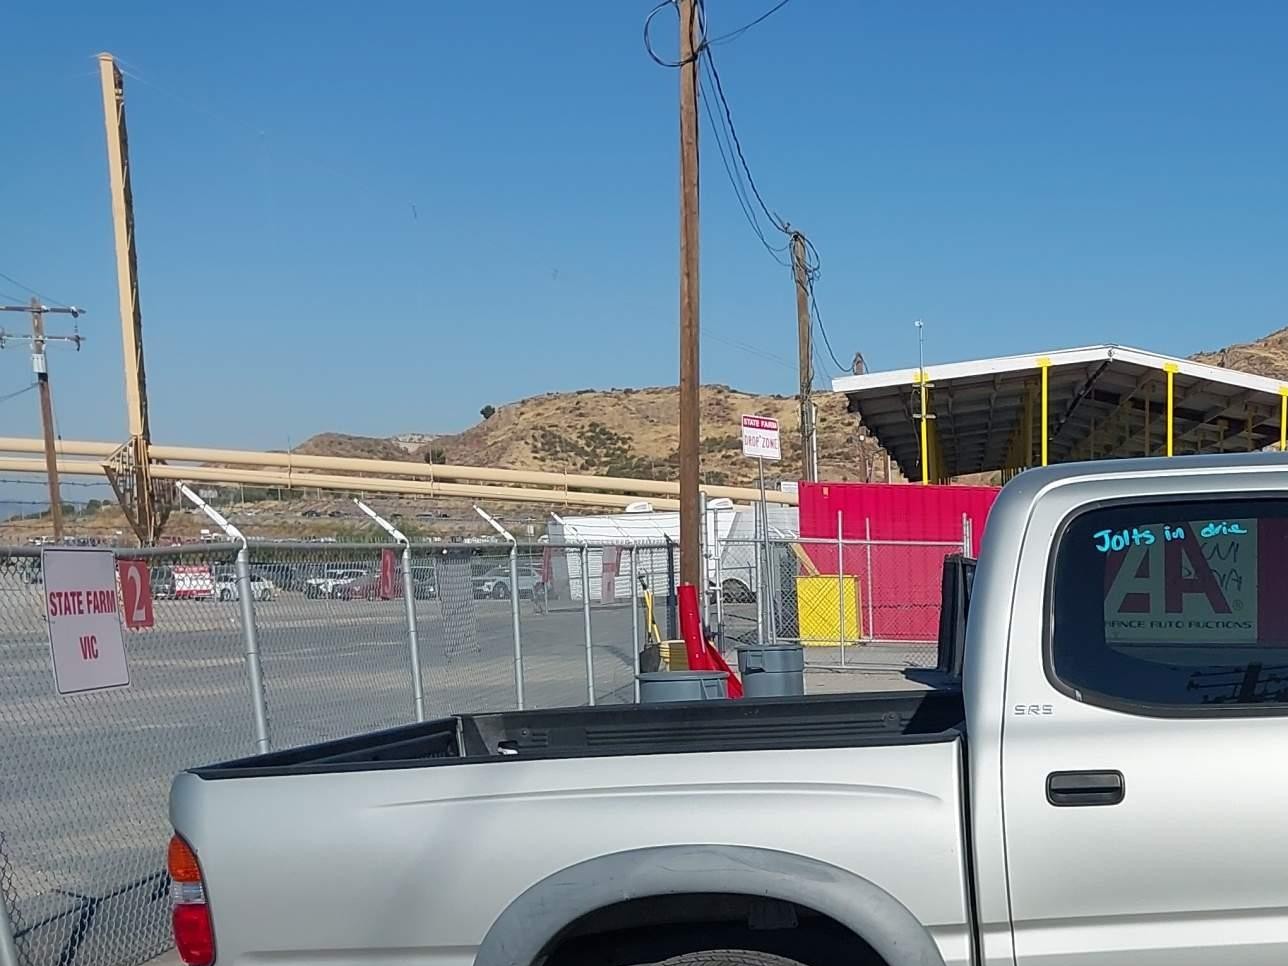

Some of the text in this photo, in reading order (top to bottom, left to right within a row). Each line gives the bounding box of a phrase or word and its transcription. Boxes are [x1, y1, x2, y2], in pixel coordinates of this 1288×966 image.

[743, 417, 760, 428] STATE
[744, 434, 778, 450] DROP ZONE
[1093, 528, 1155, 552] Jolts
[1164, 525, 1185, 541] in
[50, 590, 117, 616] STATE FARM
[127, 566, 146, 622] 2
[79, 635, 99, 660] VIC
